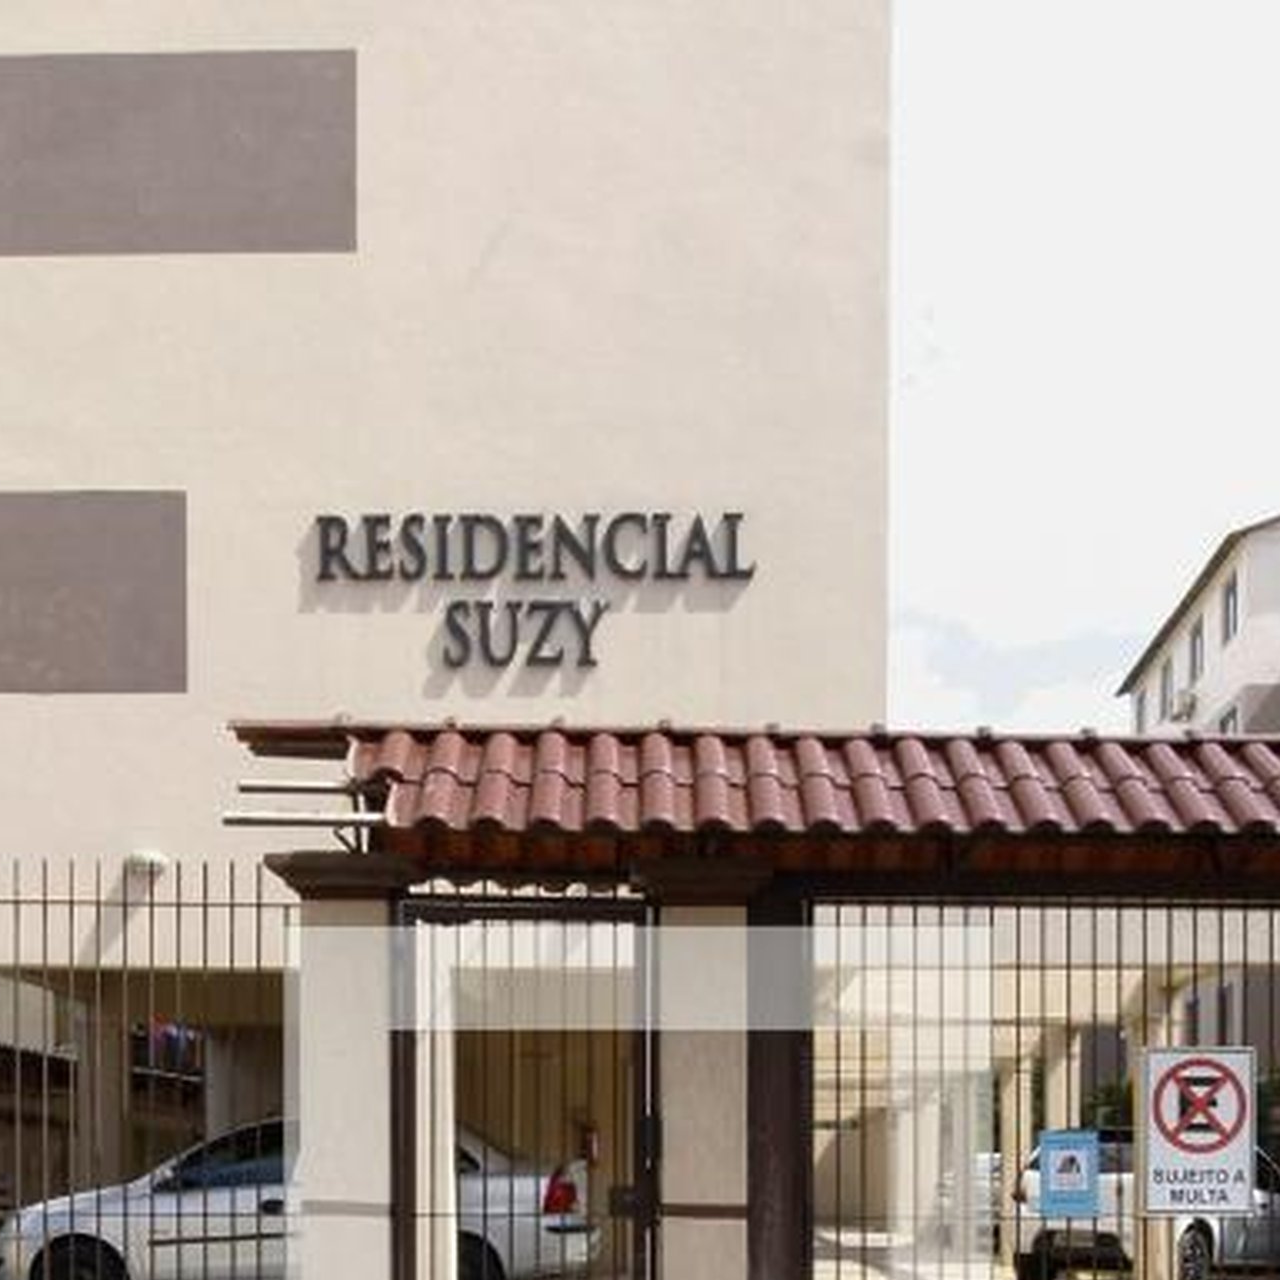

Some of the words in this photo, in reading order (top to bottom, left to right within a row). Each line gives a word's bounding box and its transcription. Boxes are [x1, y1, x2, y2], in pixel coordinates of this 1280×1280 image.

[315, 512, 756, 583] RESIDENCIAL
[442, 600, 609, 668] SUZY
[1153, 1168, 1229, 1185] SUJEITO
[1234, 1168, 1245, 1183] A
[1169, 1189, 1229, 1204] MULTA
